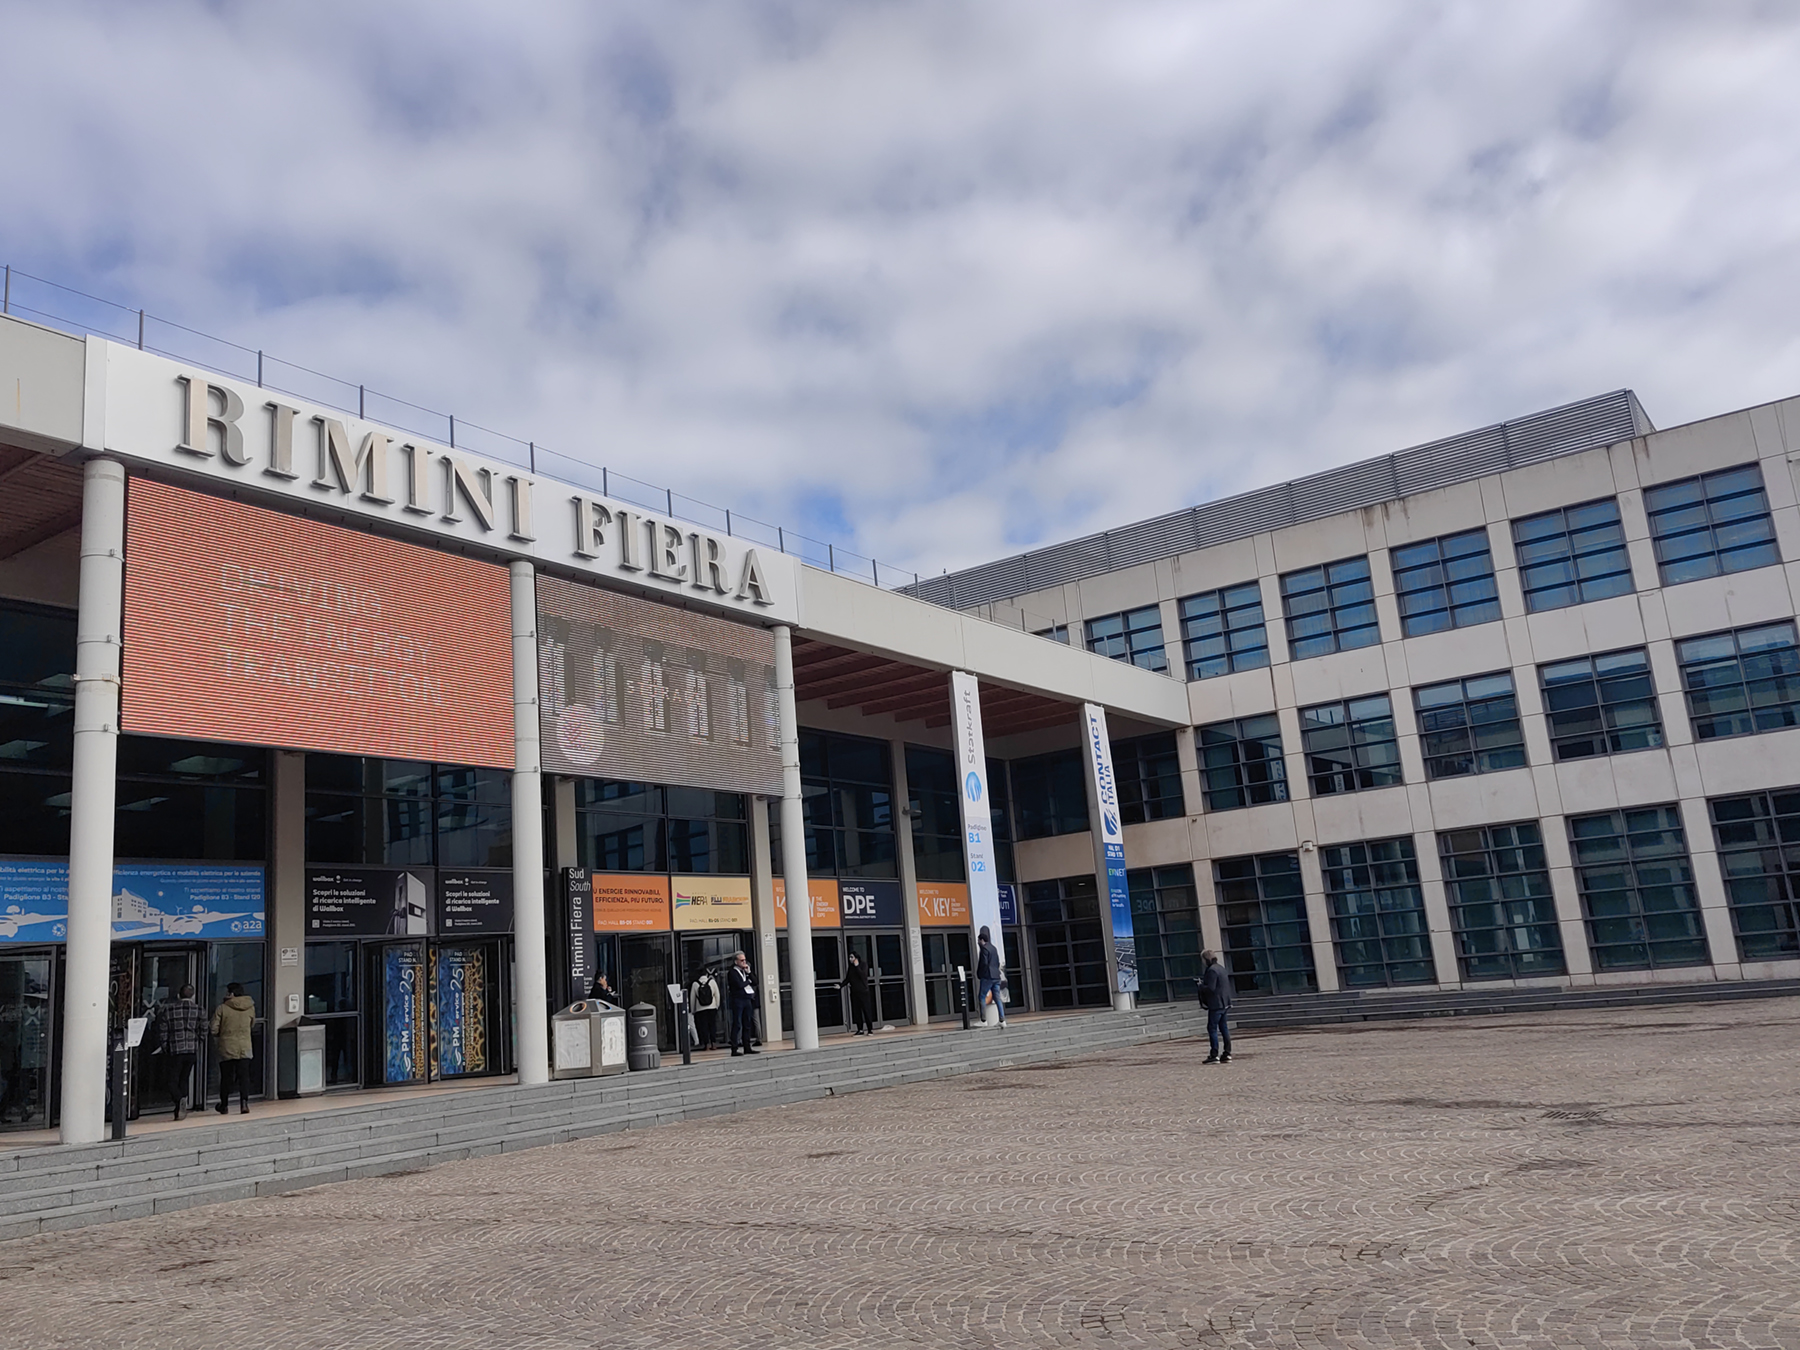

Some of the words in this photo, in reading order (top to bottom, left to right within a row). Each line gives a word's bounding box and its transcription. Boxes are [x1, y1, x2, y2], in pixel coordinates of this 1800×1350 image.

[176, 373, 536, 543] RIMINI
[571, 495, 775, 606] FIERA
[221, 563, 382, 619] DRIVING
[218, 602, 293, 643] THE
[305, 618, 433, 666] ENERGY
[218, 643, 446, 708] TRANSITION
[963, 690, 976, 764] Statkraft
[1089, 713, 1108, 805] CONTACT
[1104, 765, 1115, 805] ITALIA
[968, 832, 981, 843] B1
[139, 869, 171, 877] energetica
[569, 868, 585, 879] Sud
[312, 889, 333, 897] Scopri
[570, 880, 591, 891] South
[343, 897, 376, 905] intelligente
[843, 895, 876, 914] DPE
[933, 897, 950, 917] KEY
[242, 920, 262, 929] a2a
[571, 896, 582, 930] Fiera
[572, 933, 584, 977] Rimini
[399, 969, 415, 993] 25
[450, 968, 464, 991] 25
